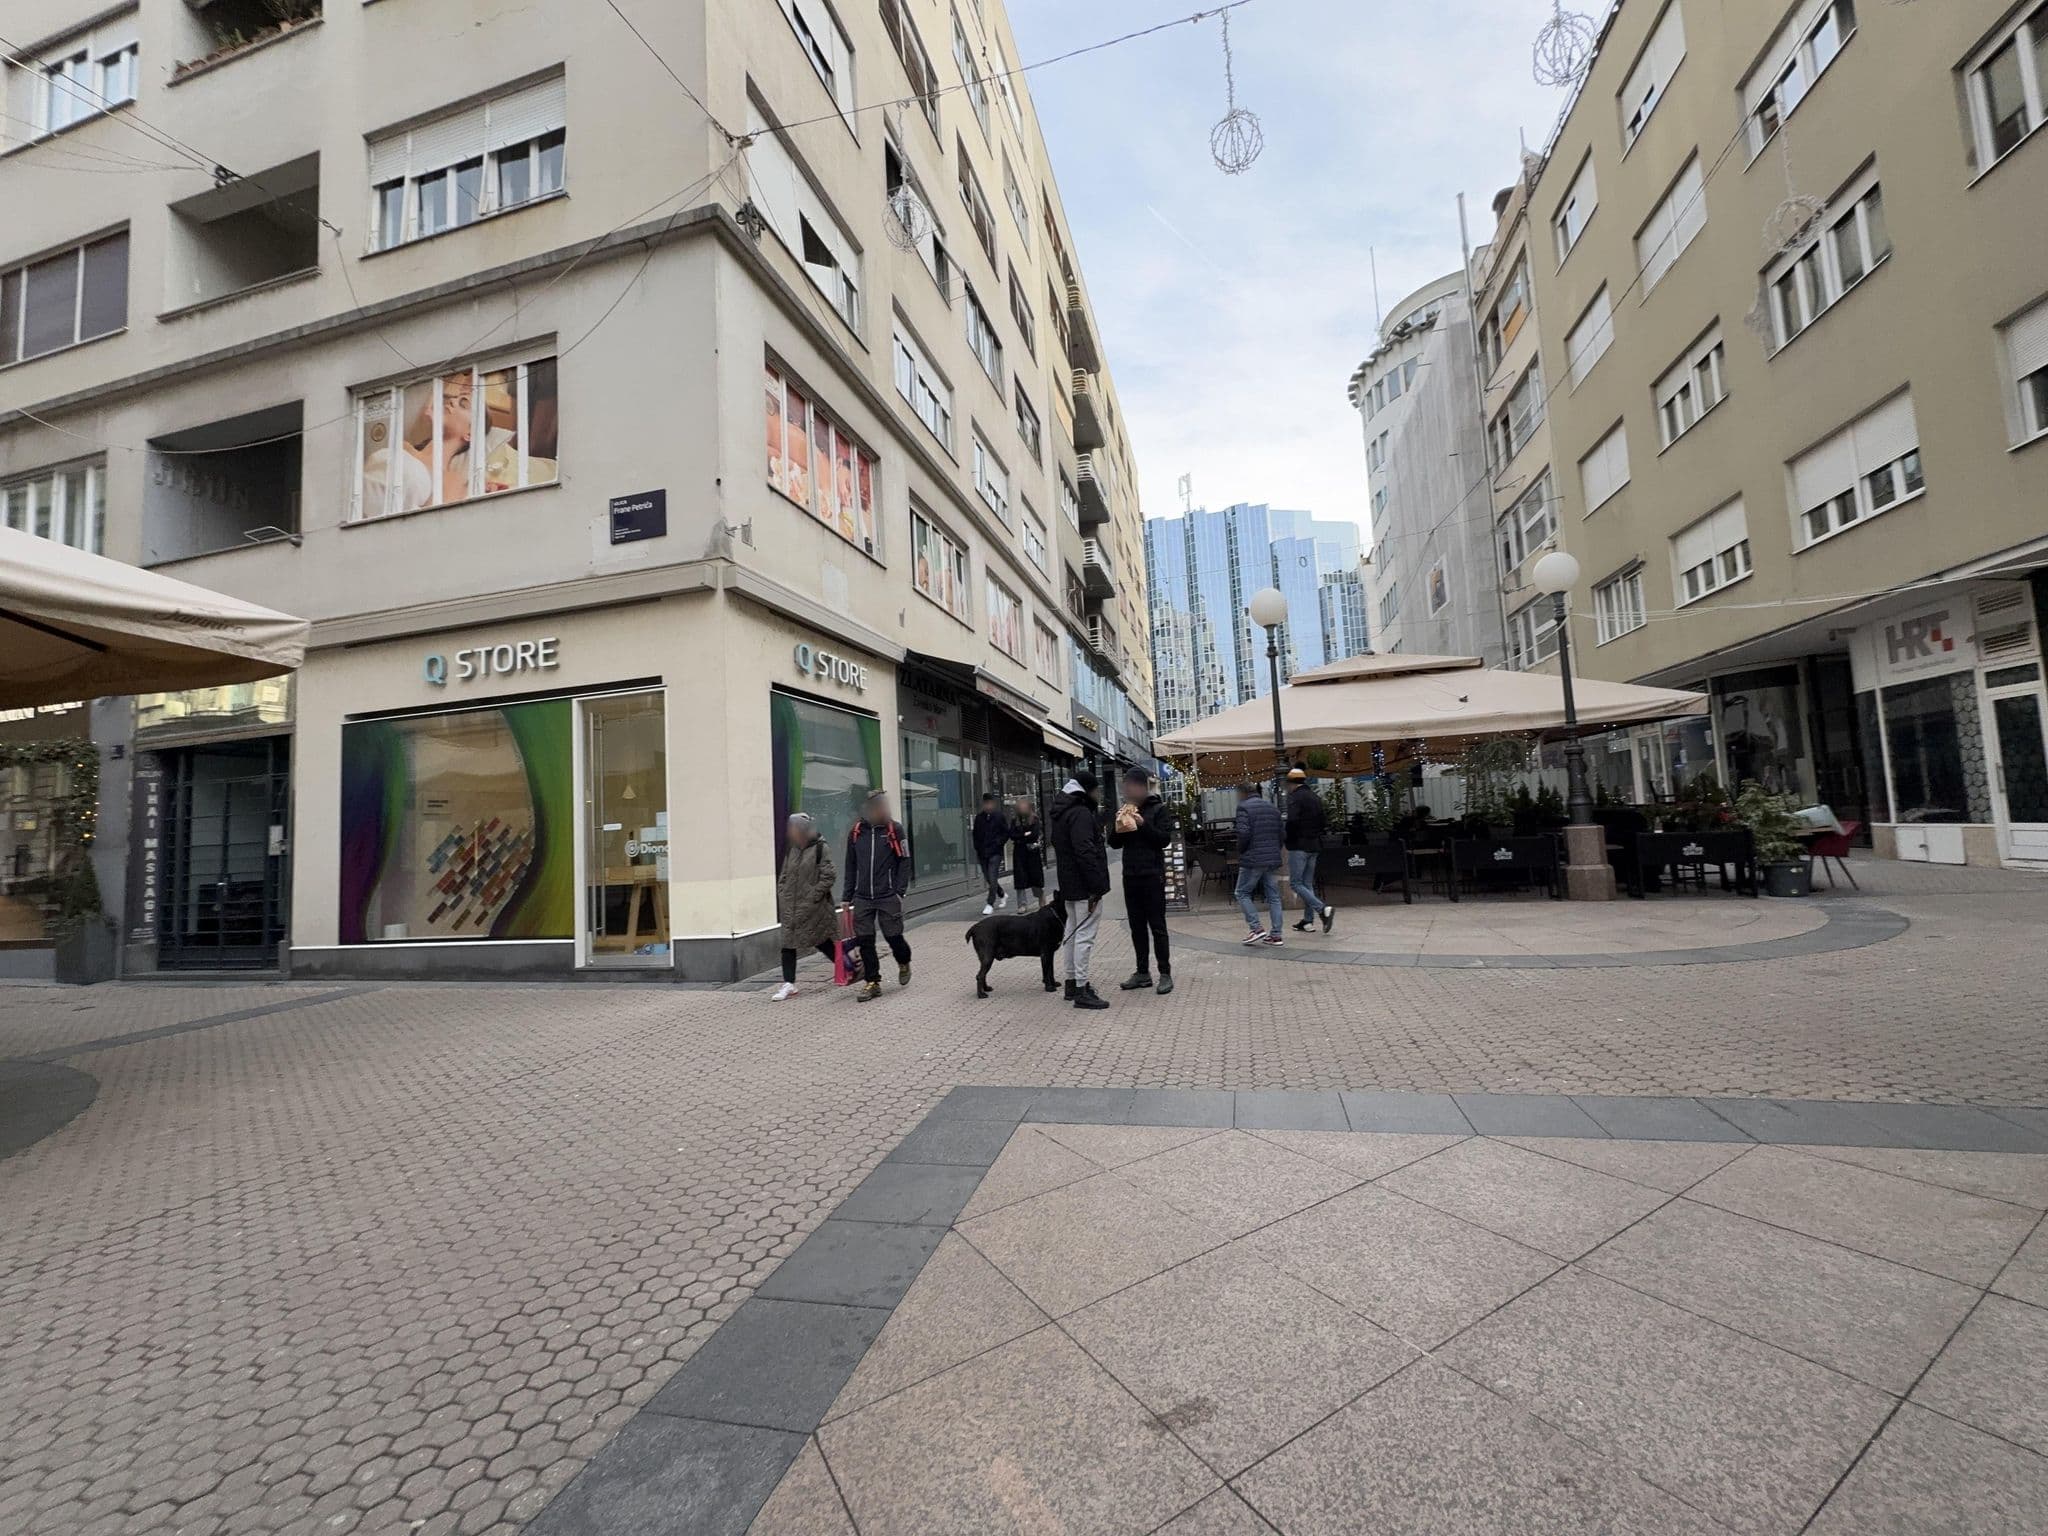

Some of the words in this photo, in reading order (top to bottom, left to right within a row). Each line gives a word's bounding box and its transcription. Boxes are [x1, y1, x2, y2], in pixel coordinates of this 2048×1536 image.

[423, 654, 447, 684] Q
[455, 637, 558, 679] STORE
[1885, 610, 1953, 664] HRT
[818, 651, 869, 691] STORE
[146, 782, 159, 830] THAI
[143, 837, 159, 924] MASSAGE
